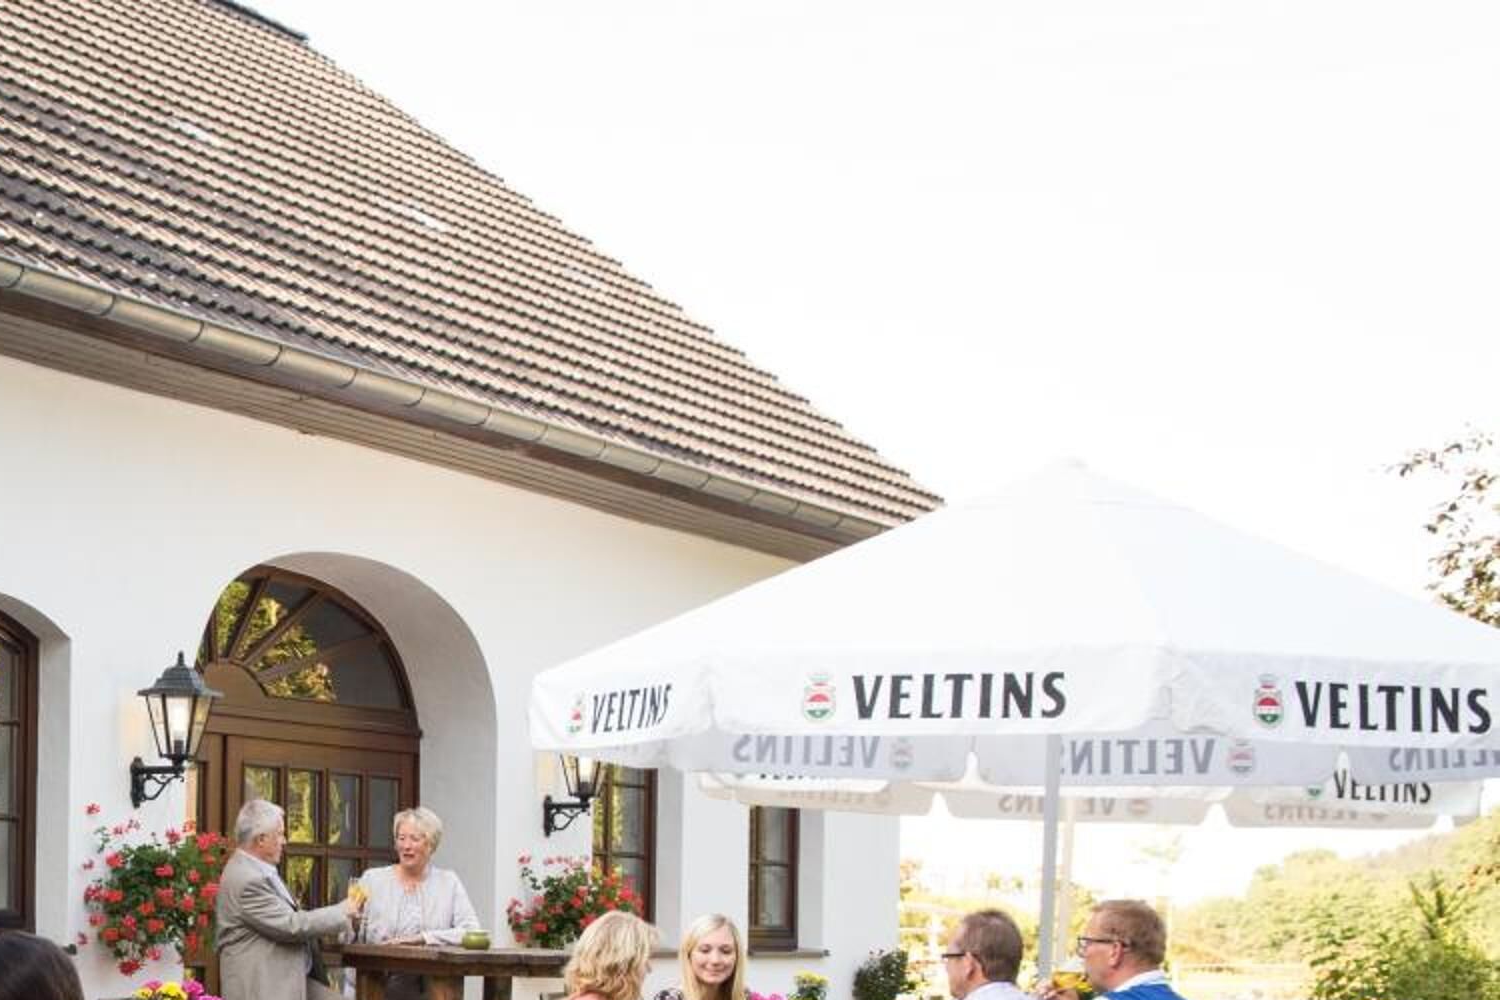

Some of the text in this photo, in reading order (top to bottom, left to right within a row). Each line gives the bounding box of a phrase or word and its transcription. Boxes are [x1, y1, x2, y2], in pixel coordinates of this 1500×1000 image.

[591, 682, 673, 734] VELTINS
[853, 672, 1067, 720] VELTINS
[1295, 681, 1492, 735] VELTINS
